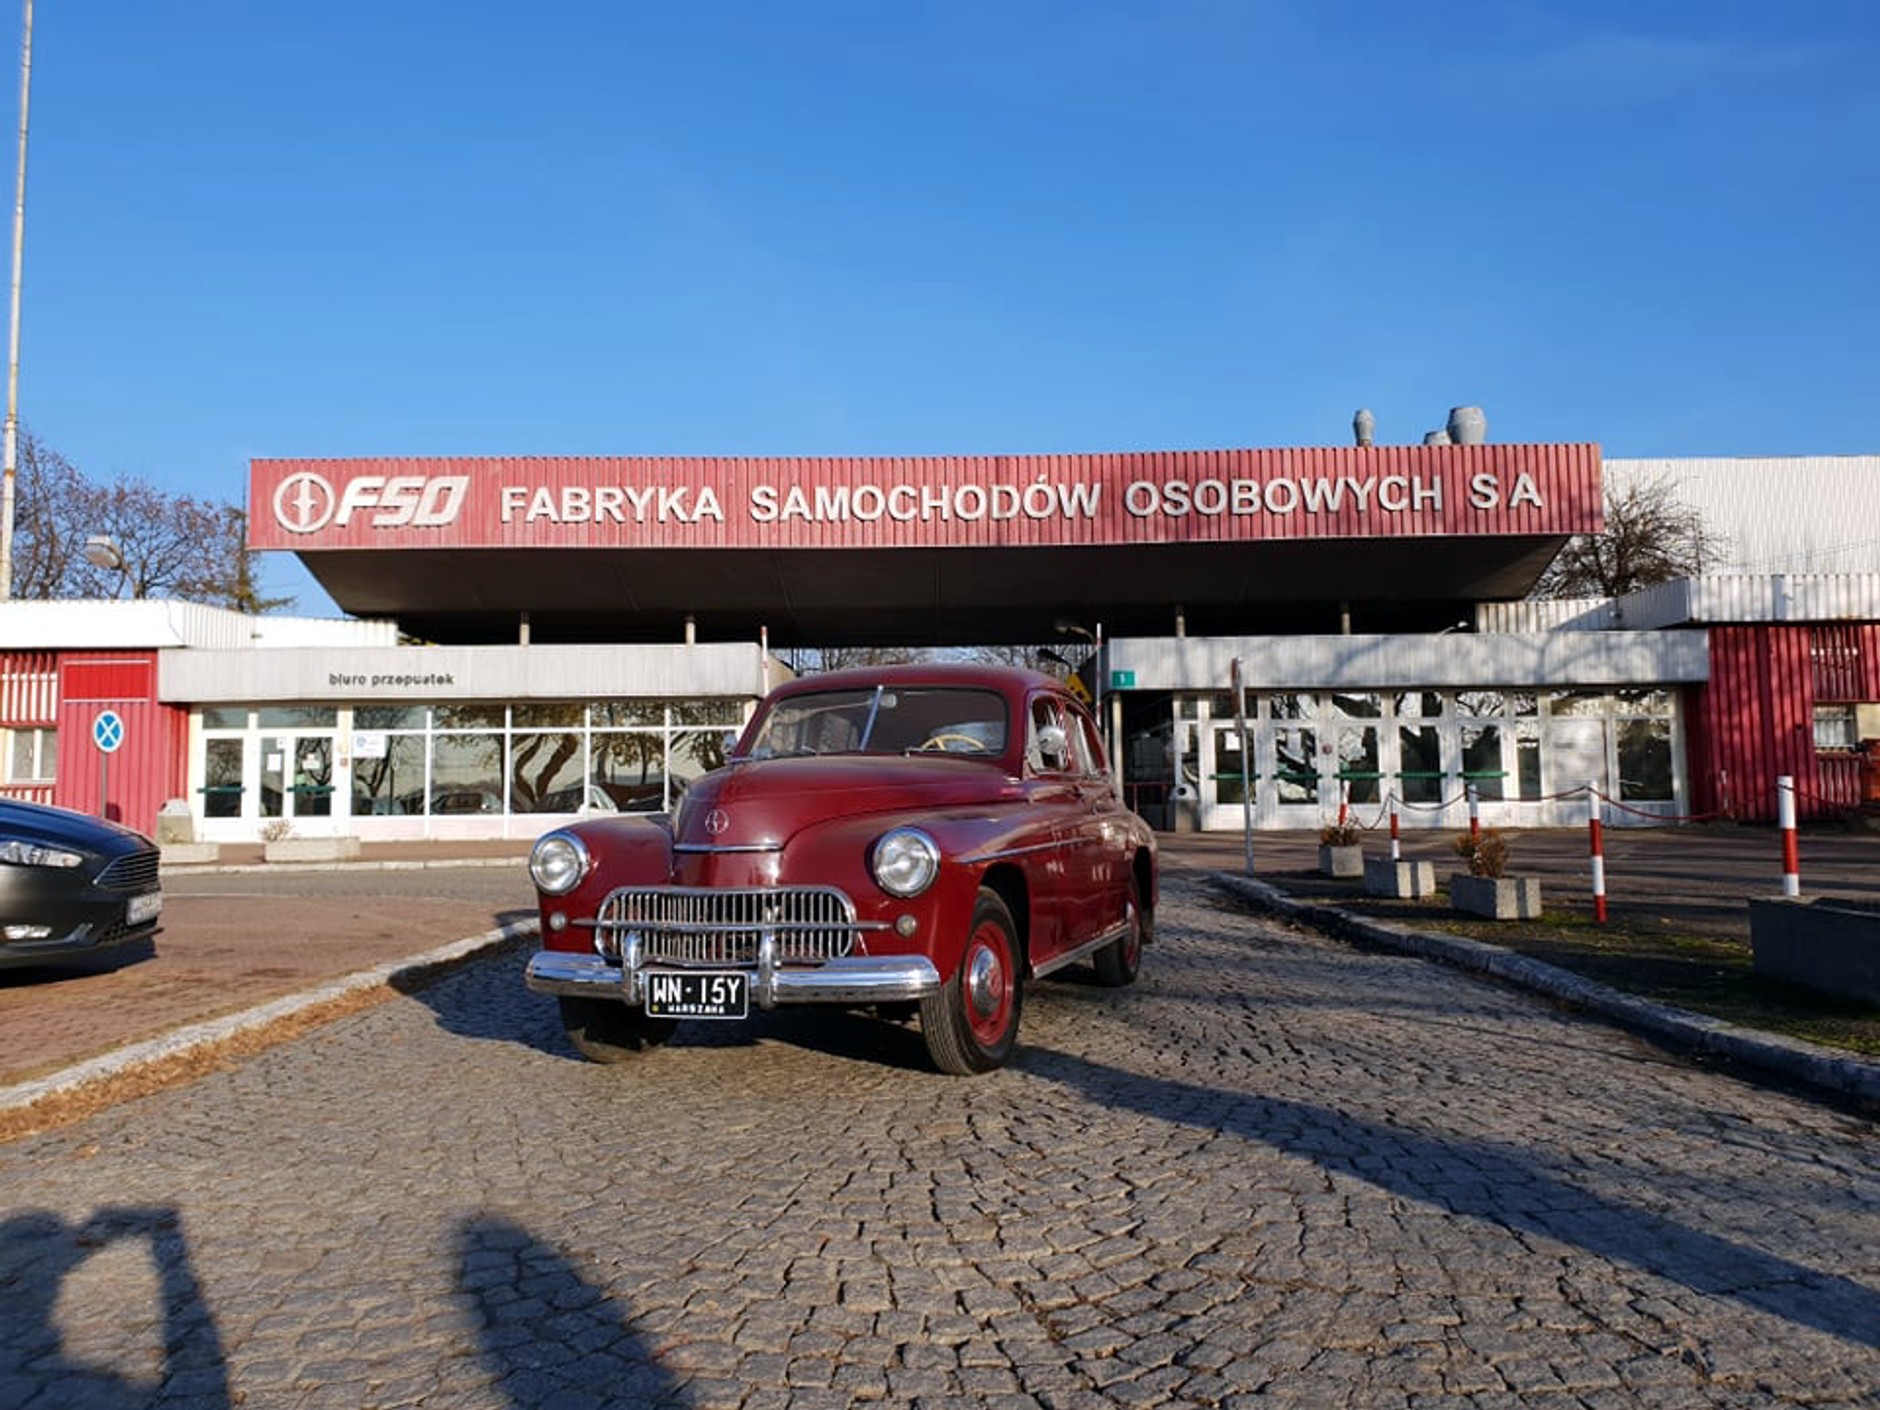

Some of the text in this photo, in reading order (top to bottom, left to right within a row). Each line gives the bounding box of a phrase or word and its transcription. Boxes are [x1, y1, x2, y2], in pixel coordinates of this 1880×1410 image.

[334, 475, 471, 527] FSO
[501, 485, 725, 523] FABRYKA
[750, 473, 1102, 522] SAMOCHODÓW
[1125, 474, 1443, 517] OSOBOWYCH
[329, 673, 366, 686] biuro
